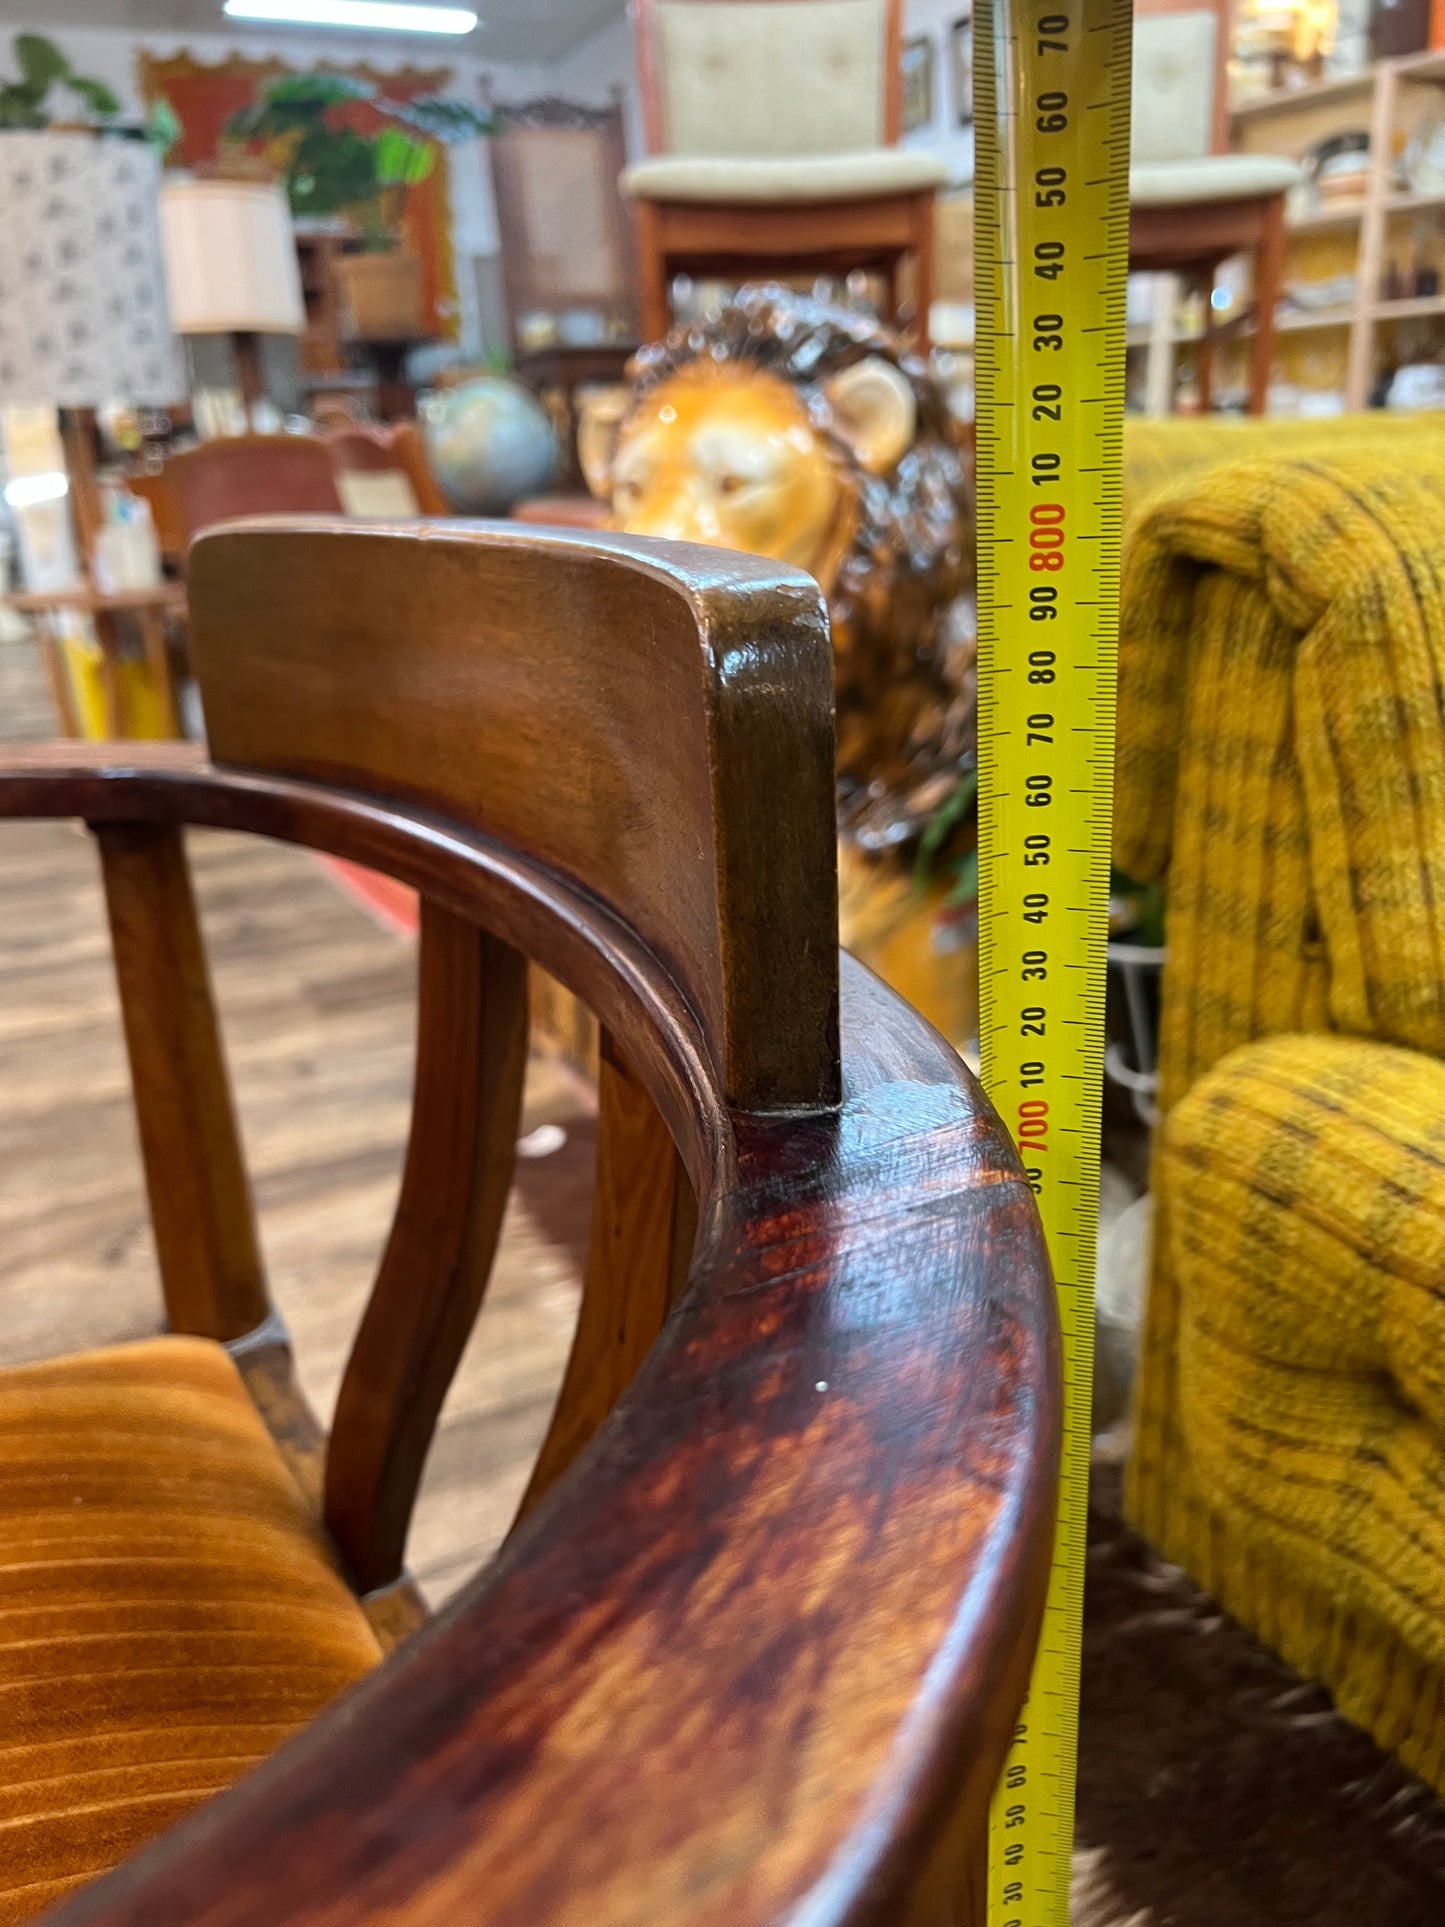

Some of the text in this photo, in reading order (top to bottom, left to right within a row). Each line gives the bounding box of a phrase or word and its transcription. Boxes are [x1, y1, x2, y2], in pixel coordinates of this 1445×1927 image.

[1037, 15, 1069, 56] 70
[1036, 91, 1068, 133] 60
[1035, 167, 1066, 208] 50
[1034, 242, 1064, 280] 40
[1033, 314, 1063, 351] 30
[1032, 384, 1062, 421] 20
[1031, 453, 1060, 486] 10
[1029, 503, 1065, 572] 800
[1029, 586, 1057, 621] 90
[1028, 651, 1056, 684] 80
[1027, 714, 1054, 746] 70
[1025, 775, 1052, 807] 60
[1024, 834, 1050, 866] 50
[1023, 893, 1048, 924] 40
[1022, 951, 1047, 981] 30
[1021, 1007, 1046, 1036] 20
[1020, 1061, 1045, 1088] 10
[1018, 1100, 1049, 1155] 700
[1006, 1765, 1026, 1789] 60
[1005, 1804, 1025, 1829] 50
[1004, 1843, 1024, 1865] 40
[1003, 1882, 1023, 1905] 30
